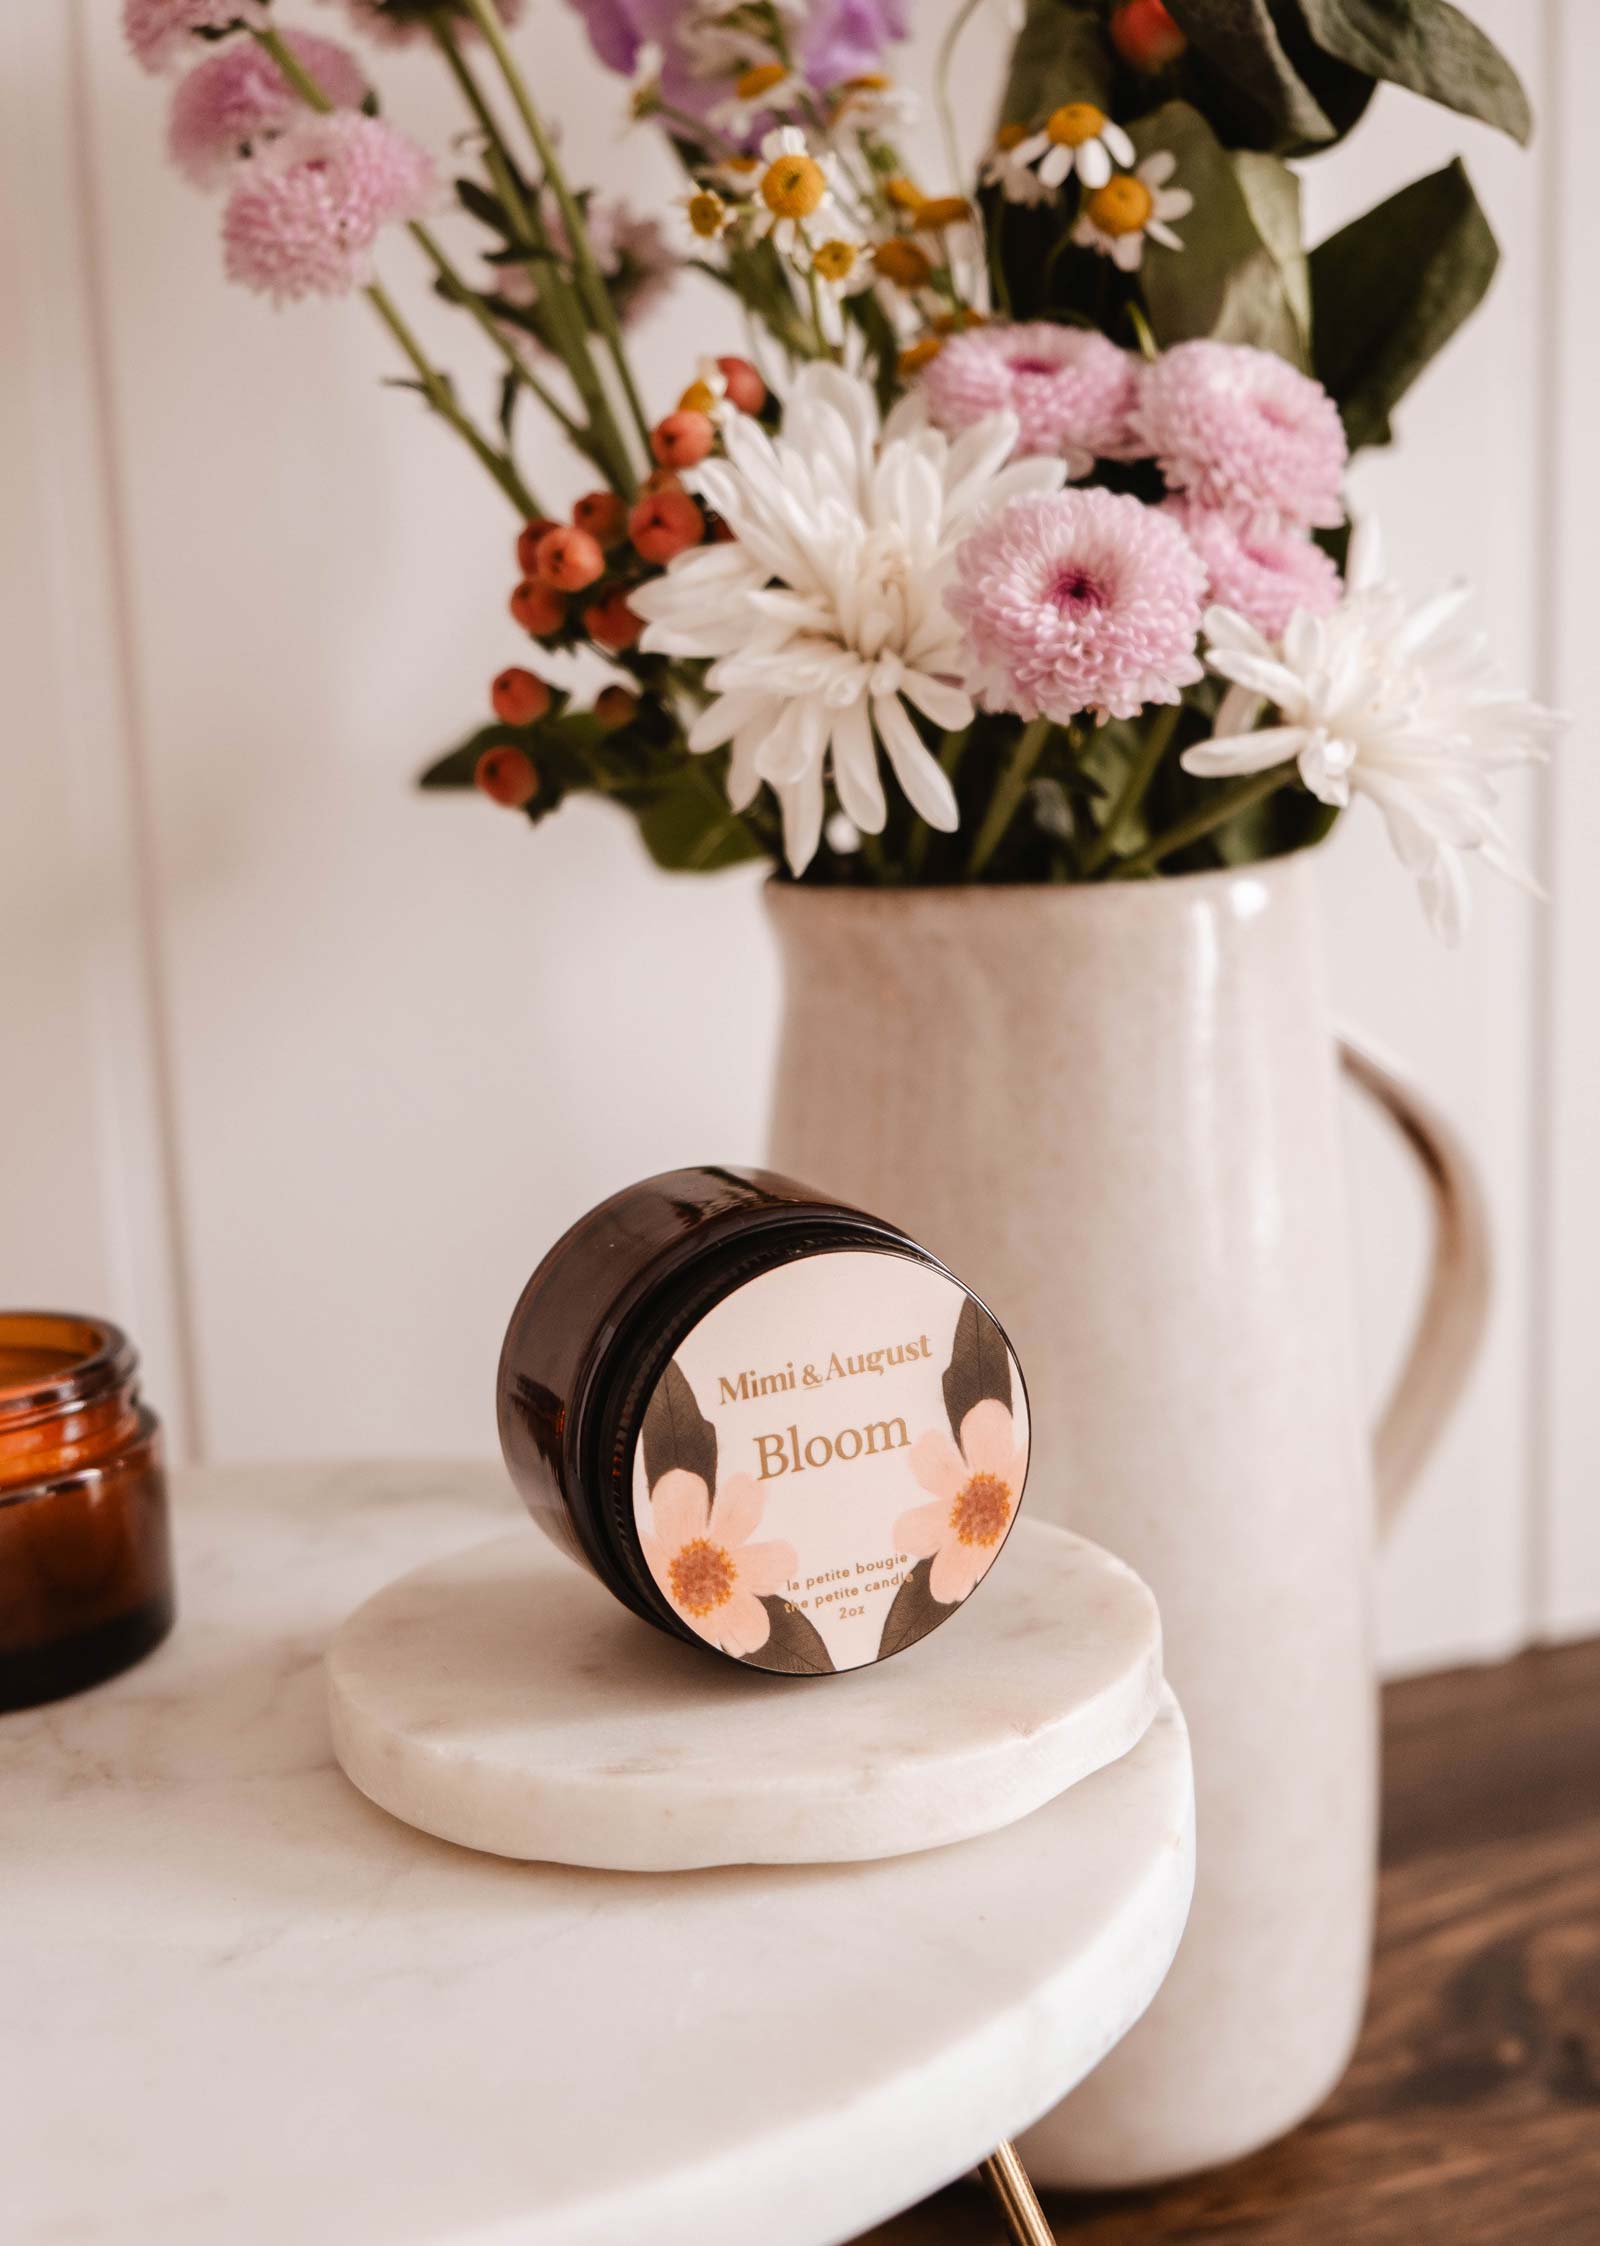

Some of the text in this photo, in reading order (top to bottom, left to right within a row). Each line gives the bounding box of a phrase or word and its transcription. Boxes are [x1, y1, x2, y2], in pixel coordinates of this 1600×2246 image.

[718, 1334, 934, 1406] Mimi & August
[752, 1417, 912, 1481] Bloom
[786, 1553, 908, 1592] la petite bougie
[815, 1586, 859, 1608] petite
[864, 1571, 914, 1592] candle
[839, 1606, 865, 1620] 2oz
